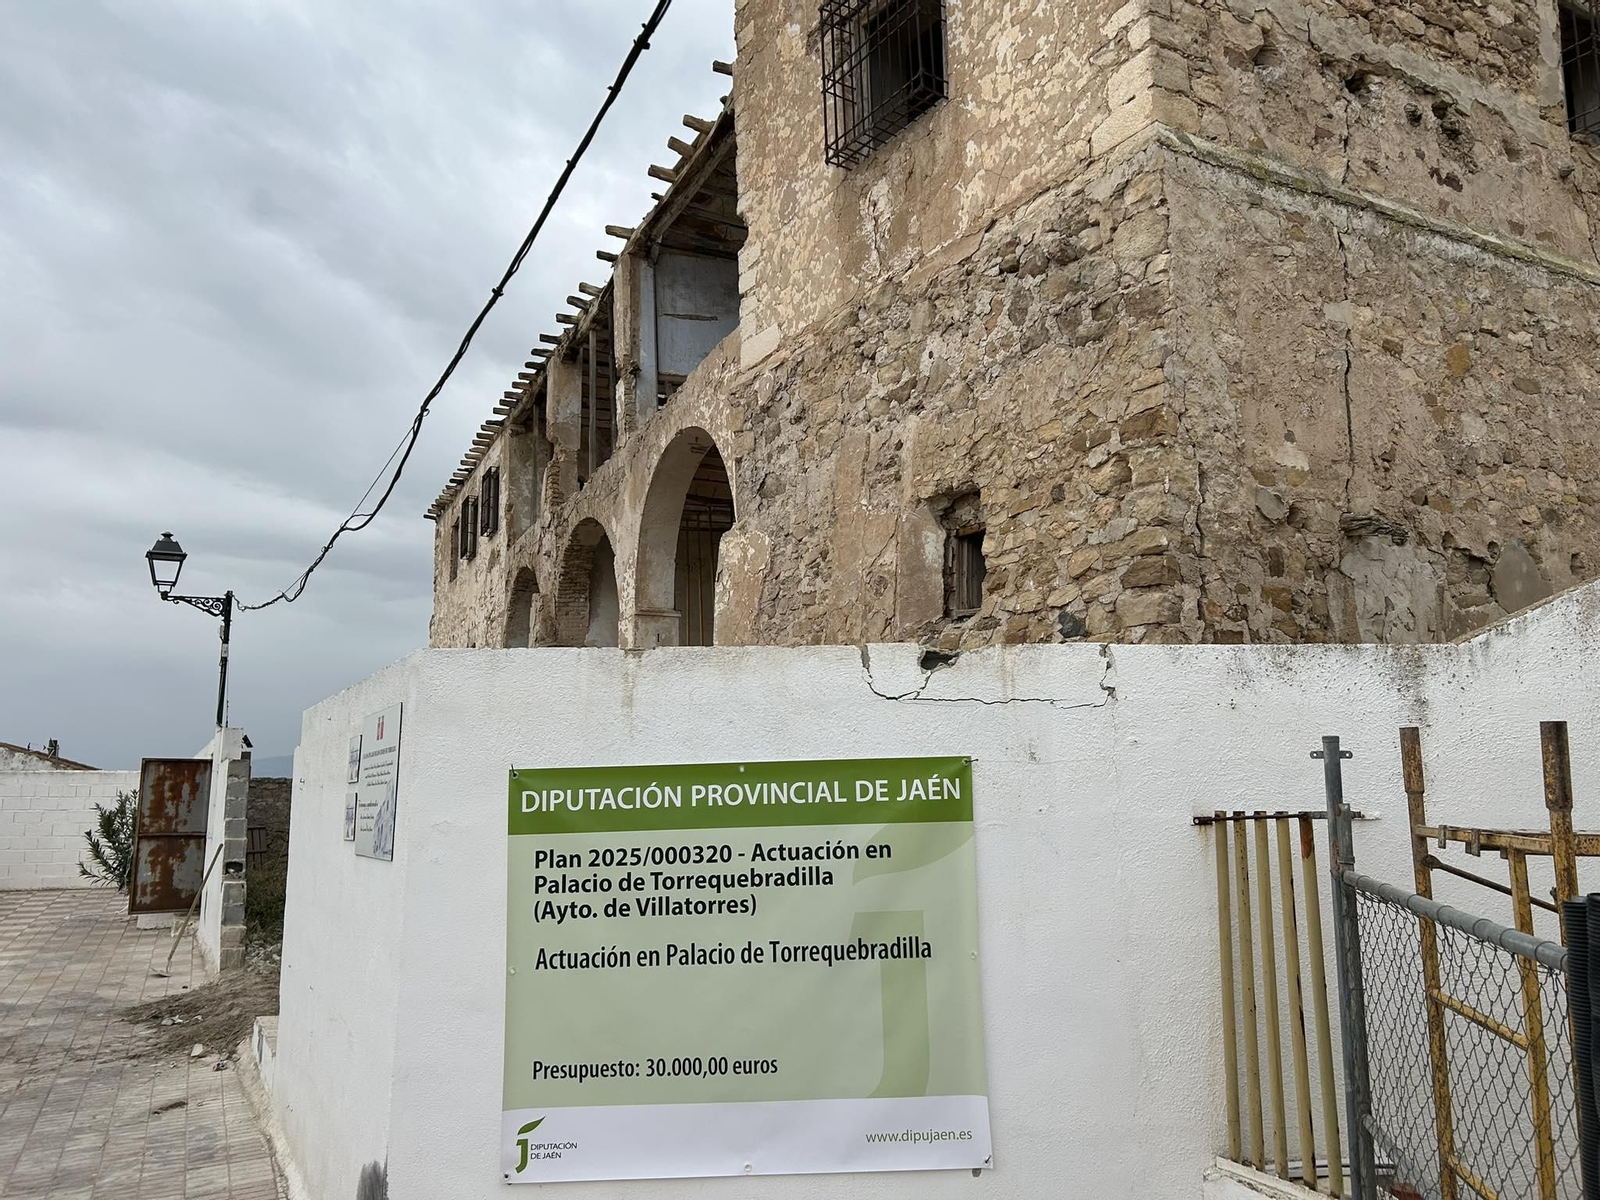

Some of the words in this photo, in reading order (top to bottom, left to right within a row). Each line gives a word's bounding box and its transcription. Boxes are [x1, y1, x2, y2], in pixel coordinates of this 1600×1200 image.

[522, 782, 681, 812] DIPUTACIÓN
[692, 781, 847, 806] PROVINCIAL
[856, 780, 889, 801] DE
[897, 774, 960, 801] JAÉN
[535, 849, 581, 869] Plan
[589, 845, 732, 867] 2025/000320
[751, 840, 859, 861] Actuación
[866, 845, 891, 858] en
[535, 873, 612, 894] Palacio
[619, 872, 645, 891] de
[650, 866, 833, 892] Torrequebradilla
[534, 900, 598, 924] (Ayto.
[604, 898, 630, 917] de
[636, 893, 757, 916] Villatorres)
[536, 946, 630, 970] Actuación
[637, 950, 659, 966] en
[667, 943, 735, 965] Palacio
[741, 941, 764, 963] de
[769, 936, 931, 966] Torrequebradilla
[533, 1060, 640, 1083] Presupuesto:
[646, 1057, 728, 1078] 30.000,00
[733, 1060, 777, 1074] euros
[530, 1142, 578, 1151] DIPUTACIÓN
[865, 1128, 973, 1145] www.dipujaen.es
[530, 1152, 541, 1160] DE
[542, 1151, 562, 1160] JAÉN
